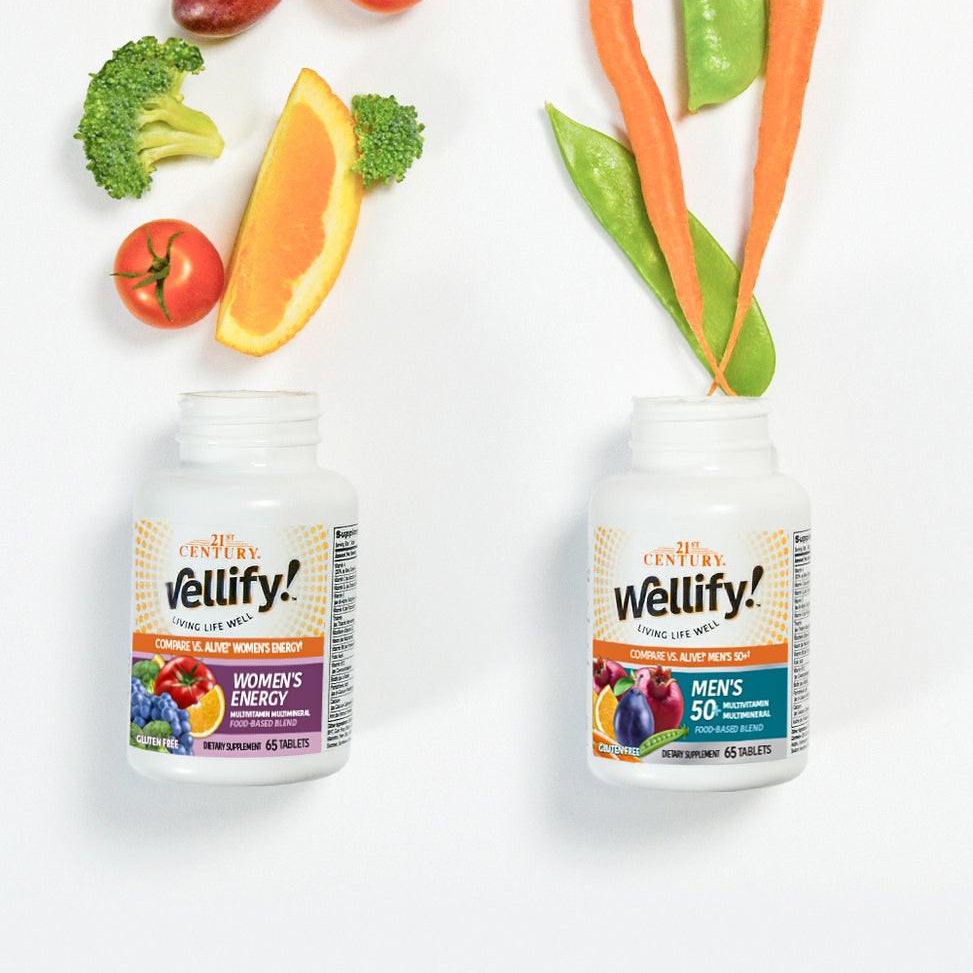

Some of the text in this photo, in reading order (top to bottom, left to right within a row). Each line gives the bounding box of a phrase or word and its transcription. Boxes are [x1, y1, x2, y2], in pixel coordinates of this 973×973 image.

[614, 565, 764, 620] Wellify!
[173, 613, 253, 631] LIVING LIFE WELL
[637, 621, 719, 639] LIVING LIFE WELL
[156, 639, 191, 651] COMPARE
[192, 641, 203, 651] VS.
[233, 643, 270, 653] WOMEN'S
[630, 649, 665, 661] COMPARE
[666, 651, 678, 661] VS.
[708, 652, 732, 661] MEN'S
[233, 672, 302, 688] WOMEN'S
[691, 679, 743, 696] MEN'S
[231, 691, 288, 706] ENERGY
[723, 700, 769, 708] MULTIVITAMIN
[230, 710, 270, 718] MULTIVITAMIN
[723, 711, 771, 719] MULTIMINERAL
[274, 719, 297, 727] BLEND
[740, 724, 764, 732] BLEND
[136, 735, 179, 748] GLUTEN FREE
[204, 738, 309, 750] DIETARY SUPPLEMENT 65 TABLETS
[598, 744, 639, 756] GLUTEN FREE
[662, 745, 771, 758] DIETARY SUPPLEMENT 65 TABLETS
